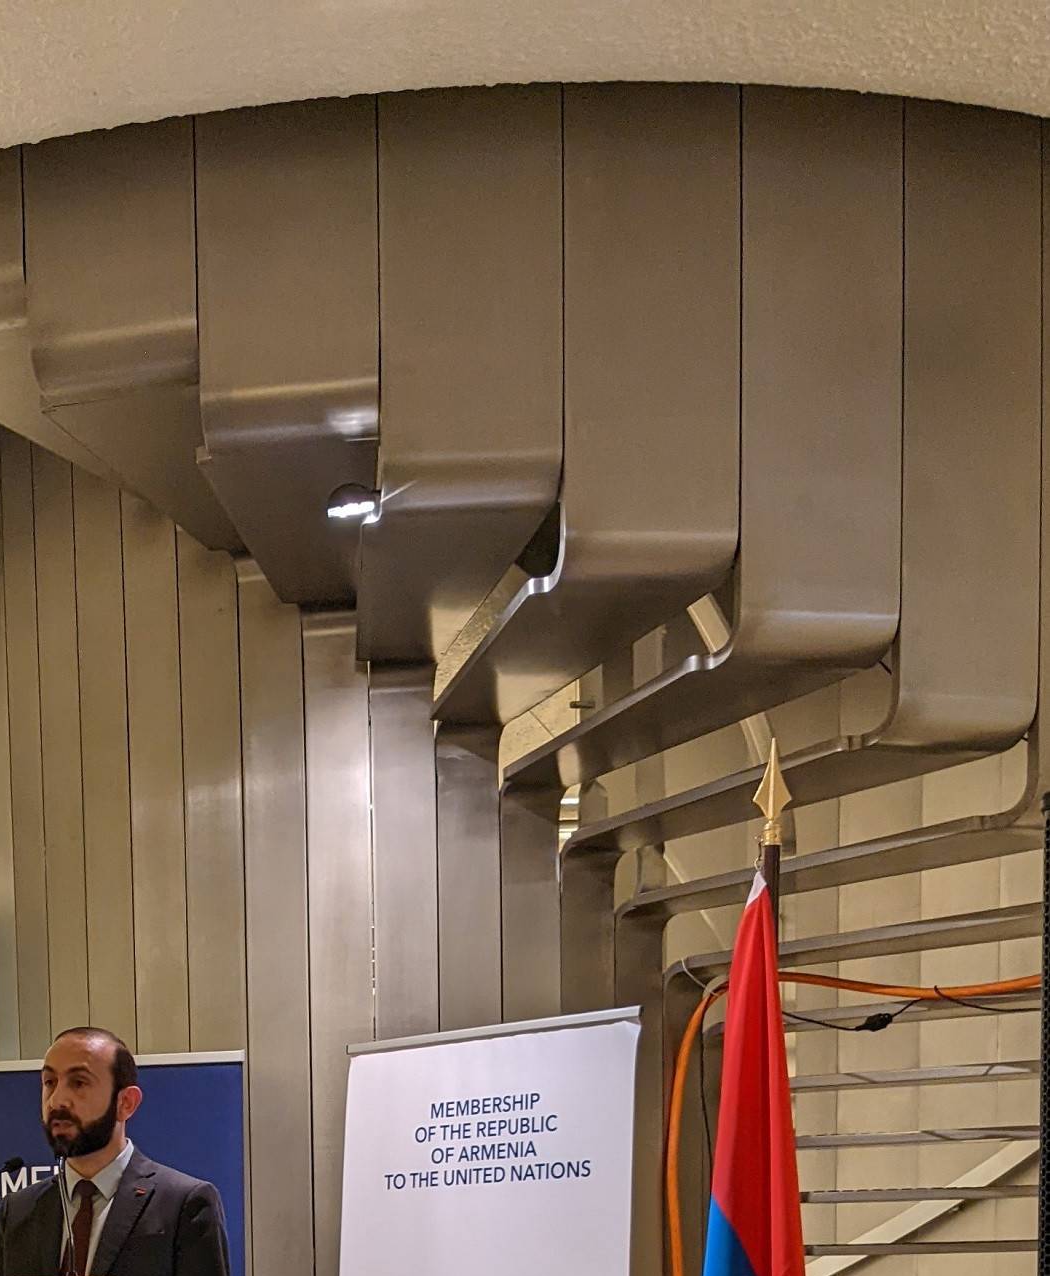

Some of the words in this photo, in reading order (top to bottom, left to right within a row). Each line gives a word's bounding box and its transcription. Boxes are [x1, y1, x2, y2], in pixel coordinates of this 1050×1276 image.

[430, 1092, 540, 1119] MEMBERSHIP
[414, 1126, 436, 1143] OF
[440, 1122, 471, 1141] THE
[477, 1114, 558, 1138] REPUBLIC
[430, 1147, 454, 1165] OF
[458, 1141, 537, 1162] ARMENIA
[384, 1173, 406, 1190] TO
[410, 1170, 439, 1188] THE
[443, 1166, 506, 1186] UNITED
[510, 1159, 591, 1182] NATIONS
